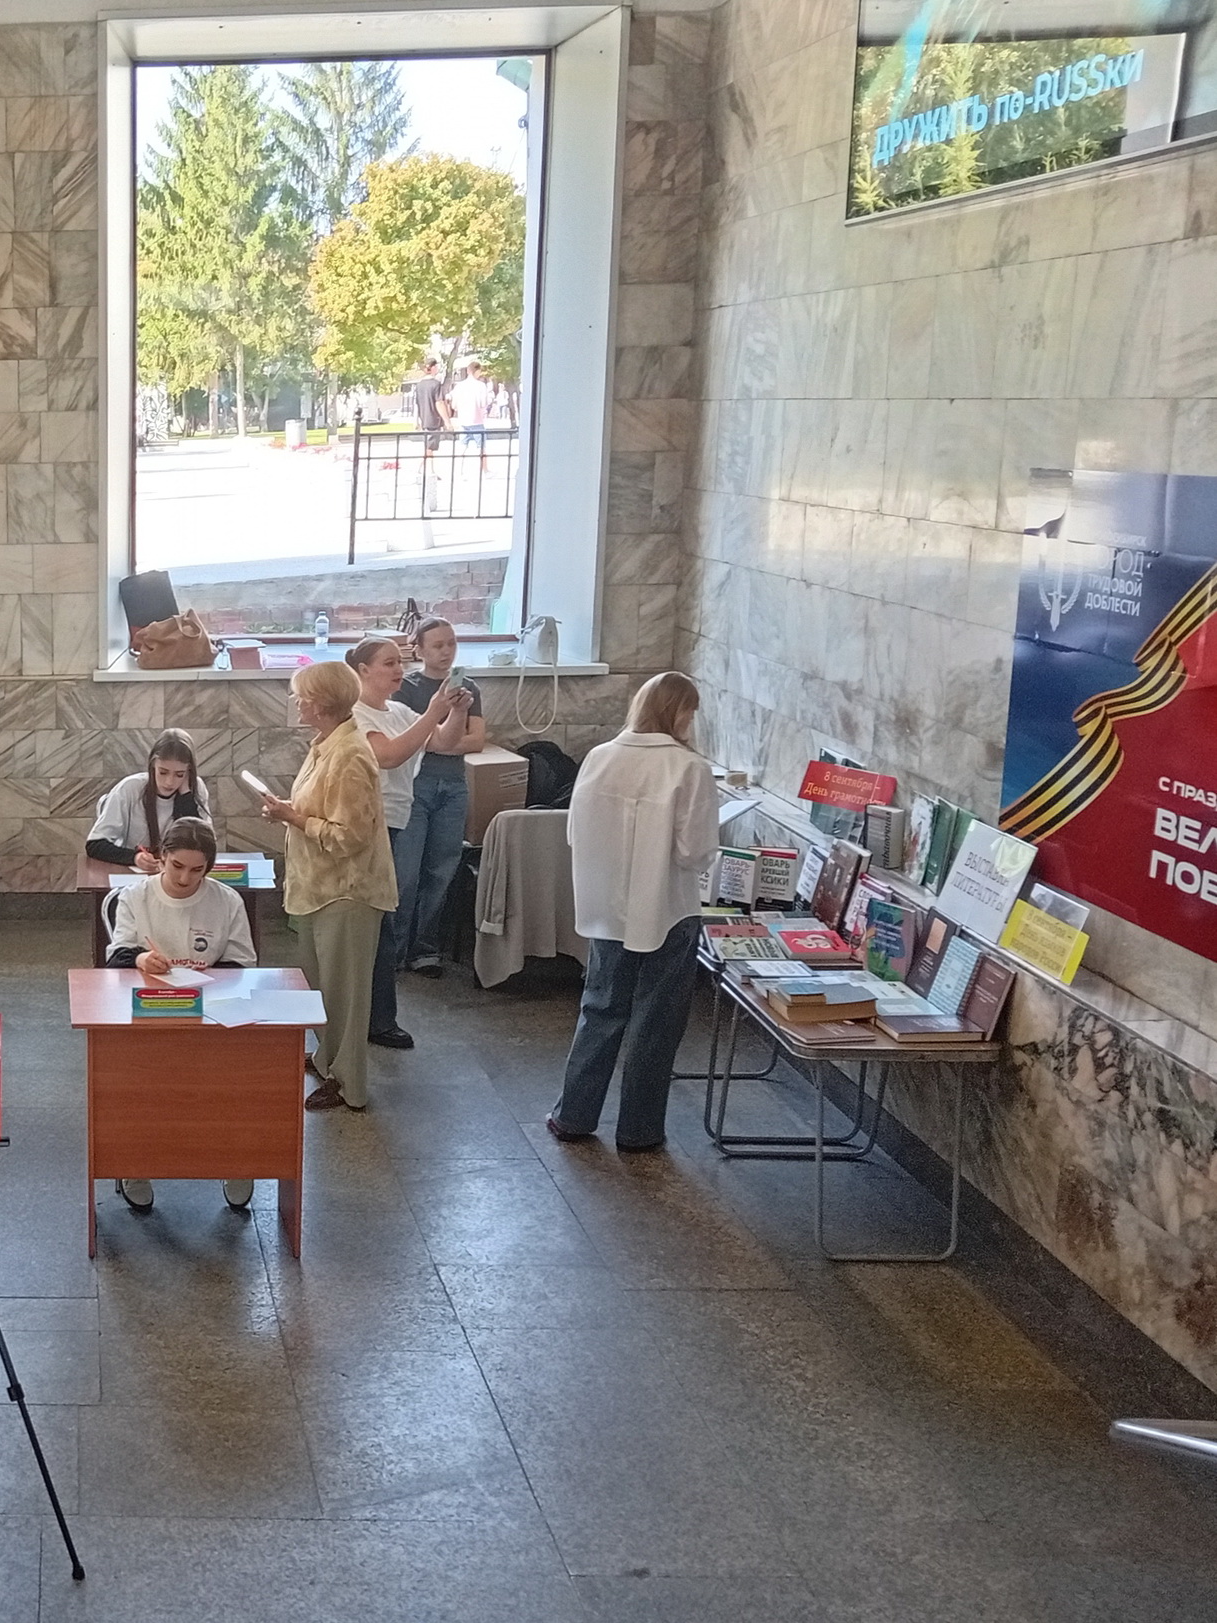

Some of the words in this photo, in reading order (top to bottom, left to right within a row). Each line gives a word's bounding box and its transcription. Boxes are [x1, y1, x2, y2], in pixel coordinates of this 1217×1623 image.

[873, 95, 988, 168] ДРУЖИТЬ
[1086, 573, 1143, 597] ТРУДОВОЙ
[1085, 592, 1141, 616] ДОБЛЕСТИ
[804, 782, 828, 797] День
[823, 771, 831, 781] 8
[832, 774, 873, 792] сентября
[1158, 776, 1171, 792] С
[1172, 780, 1217, 811] ПРАЗ
